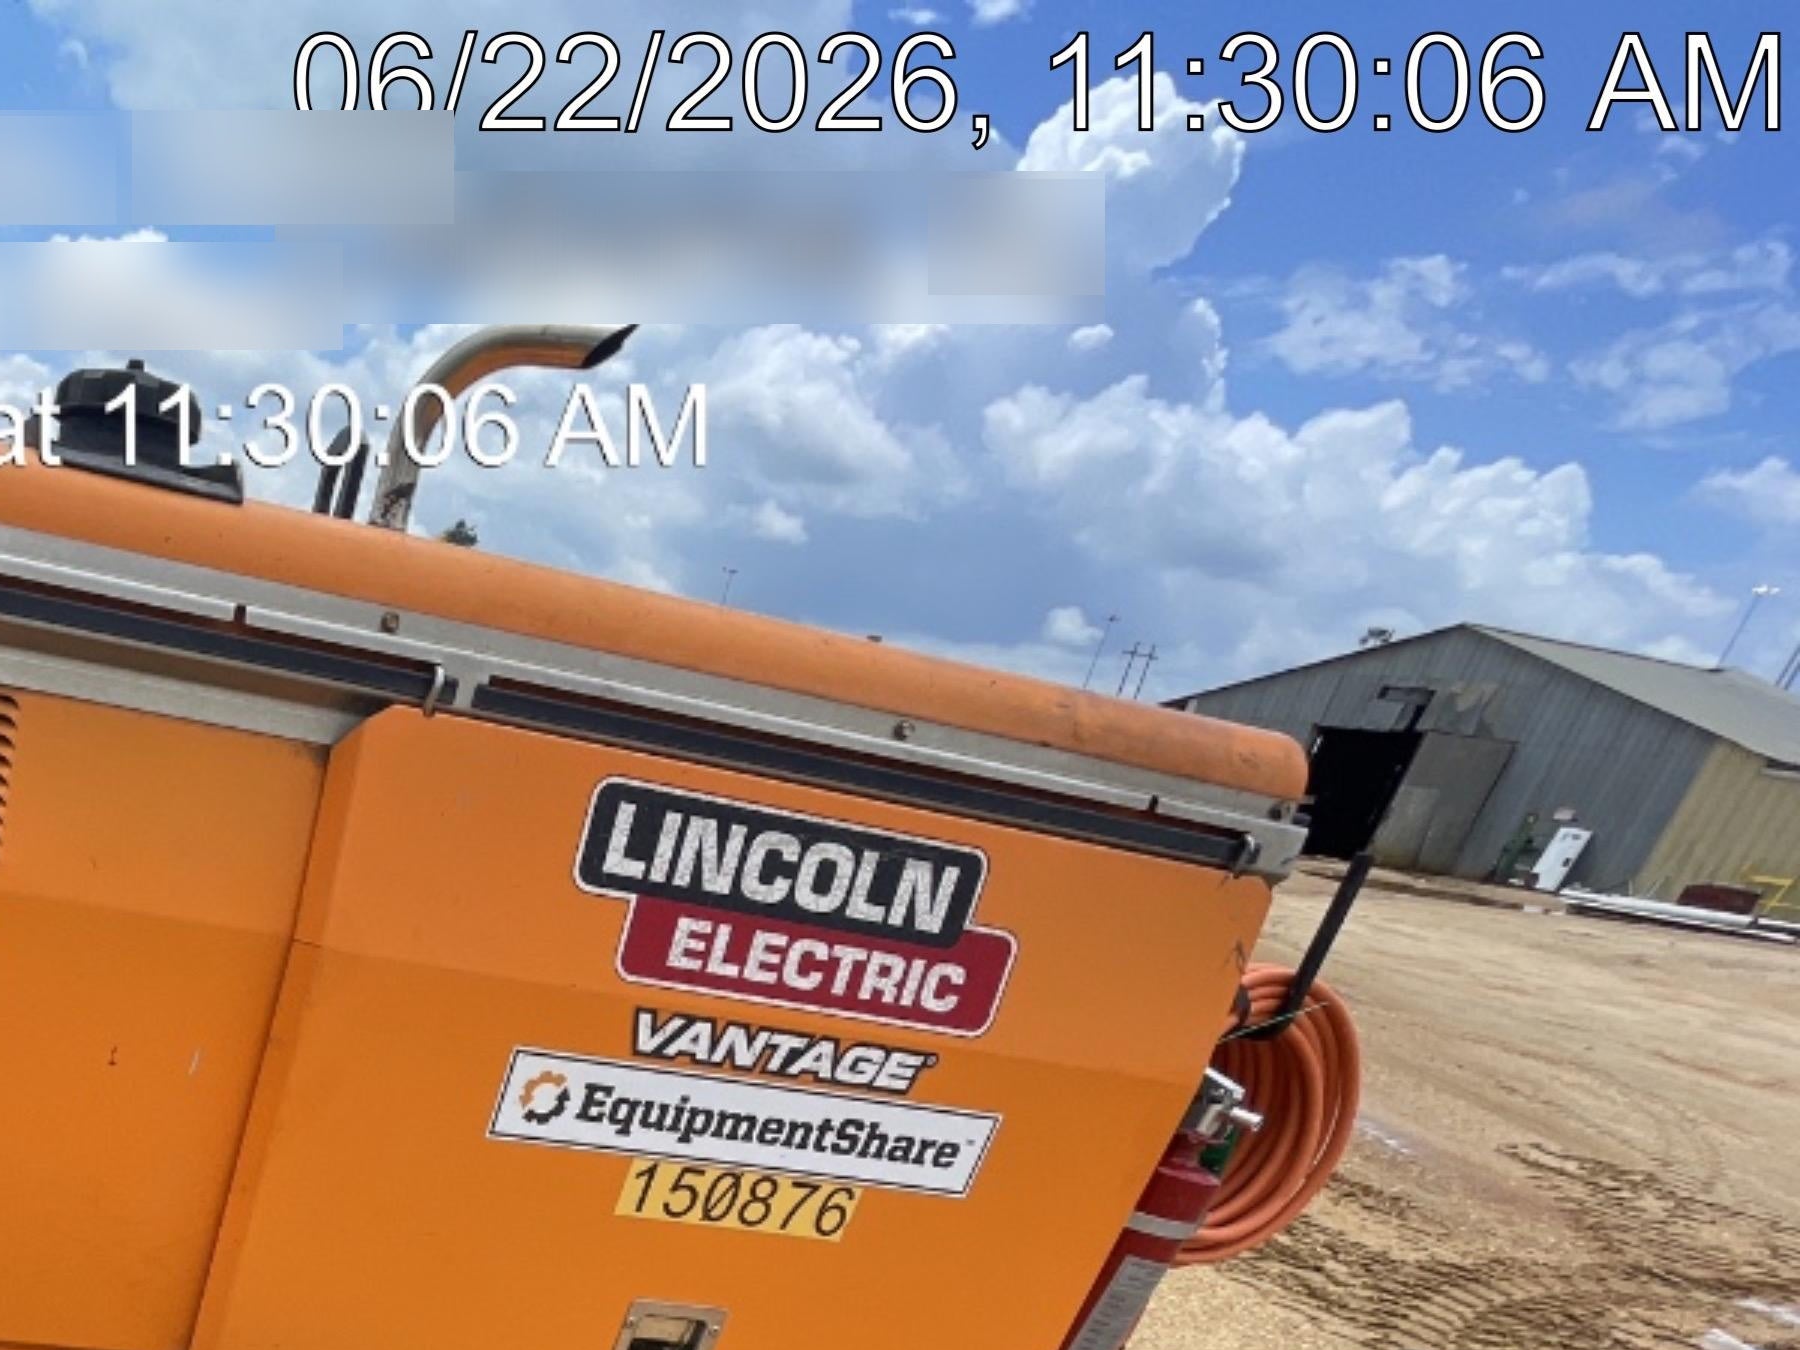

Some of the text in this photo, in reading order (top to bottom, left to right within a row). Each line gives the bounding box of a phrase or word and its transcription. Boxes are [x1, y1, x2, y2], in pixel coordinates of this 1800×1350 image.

[600, 800, 960, 934] LINCOLN
[665, 917, 968, 1013] ELECTRIC
[634, 1010, 922, 1093] VANTAGE
[574, 1082, 961, 1170] EquipmentShare
[633, 1162, 856, 1237] 150876
